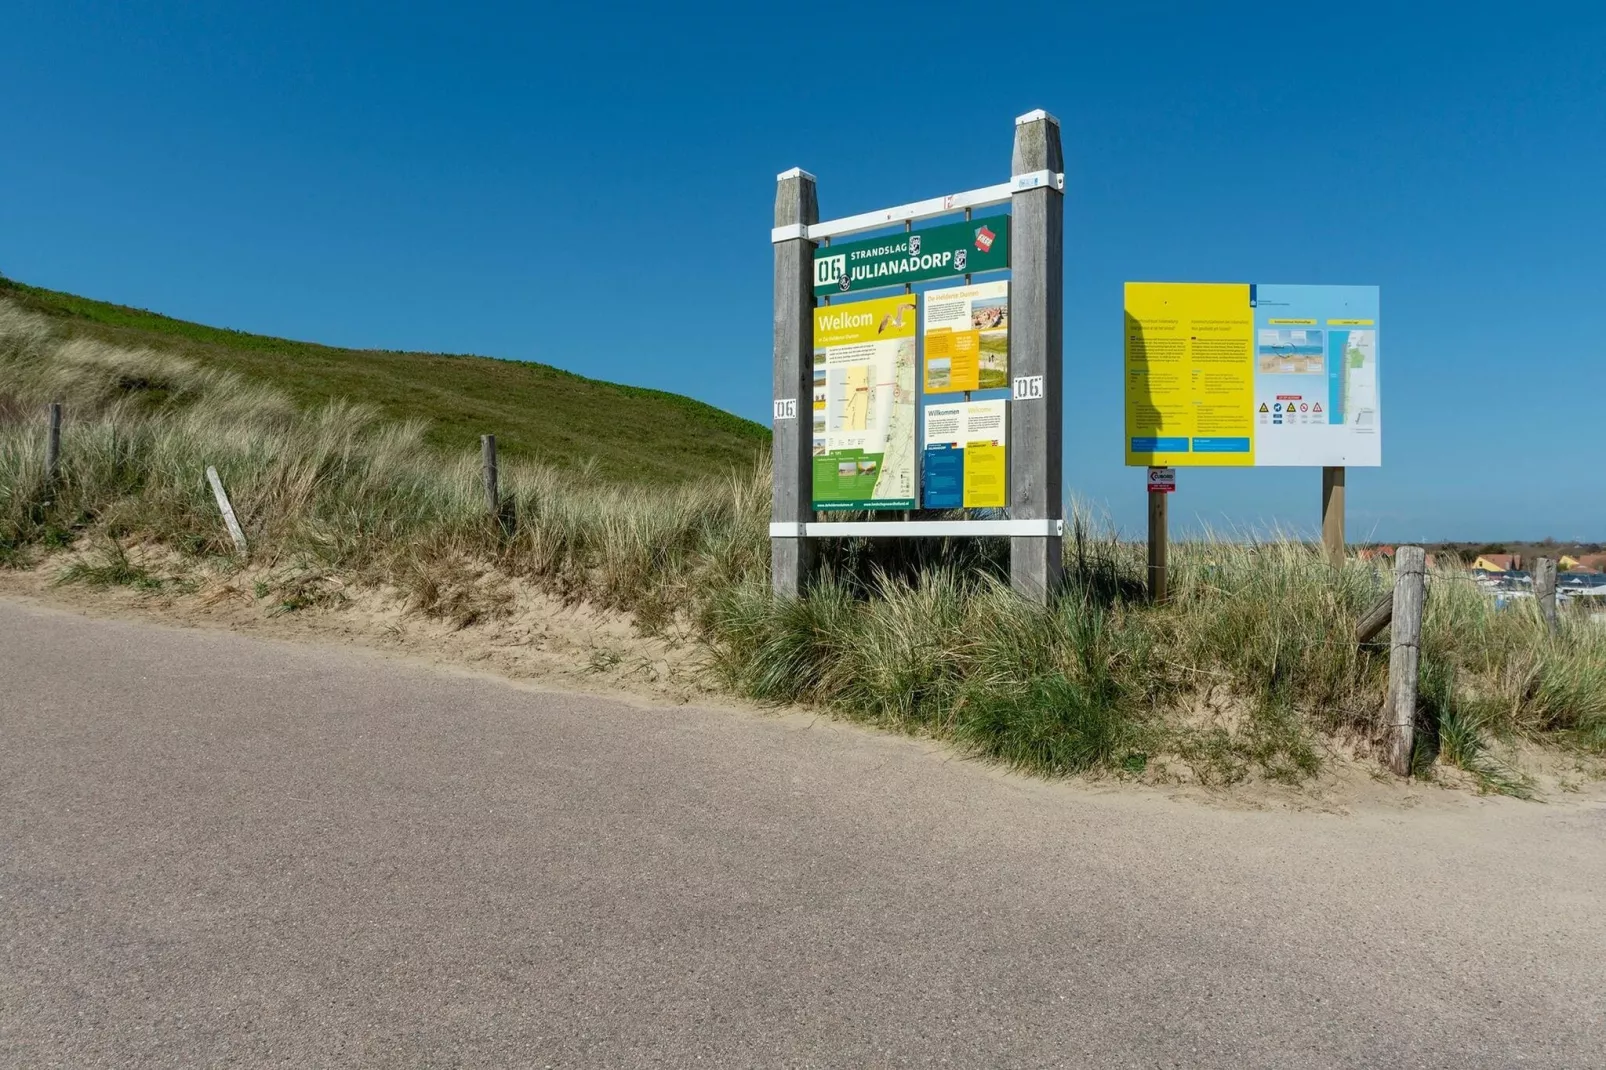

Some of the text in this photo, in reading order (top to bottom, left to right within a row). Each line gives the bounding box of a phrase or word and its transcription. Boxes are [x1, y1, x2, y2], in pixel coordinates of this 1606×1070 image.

[851, 243, 908, 260] STRANDSLAG
[818, 258, 842, 283] 06
[850, 251, 952, 281] JULIANADORP
[818, 312, 873, 332] Welkom
[1018, 379, 1039, 397] 06
[777, 402, 793, 417] 06
[928, 409, 960, 417] Willkommen
